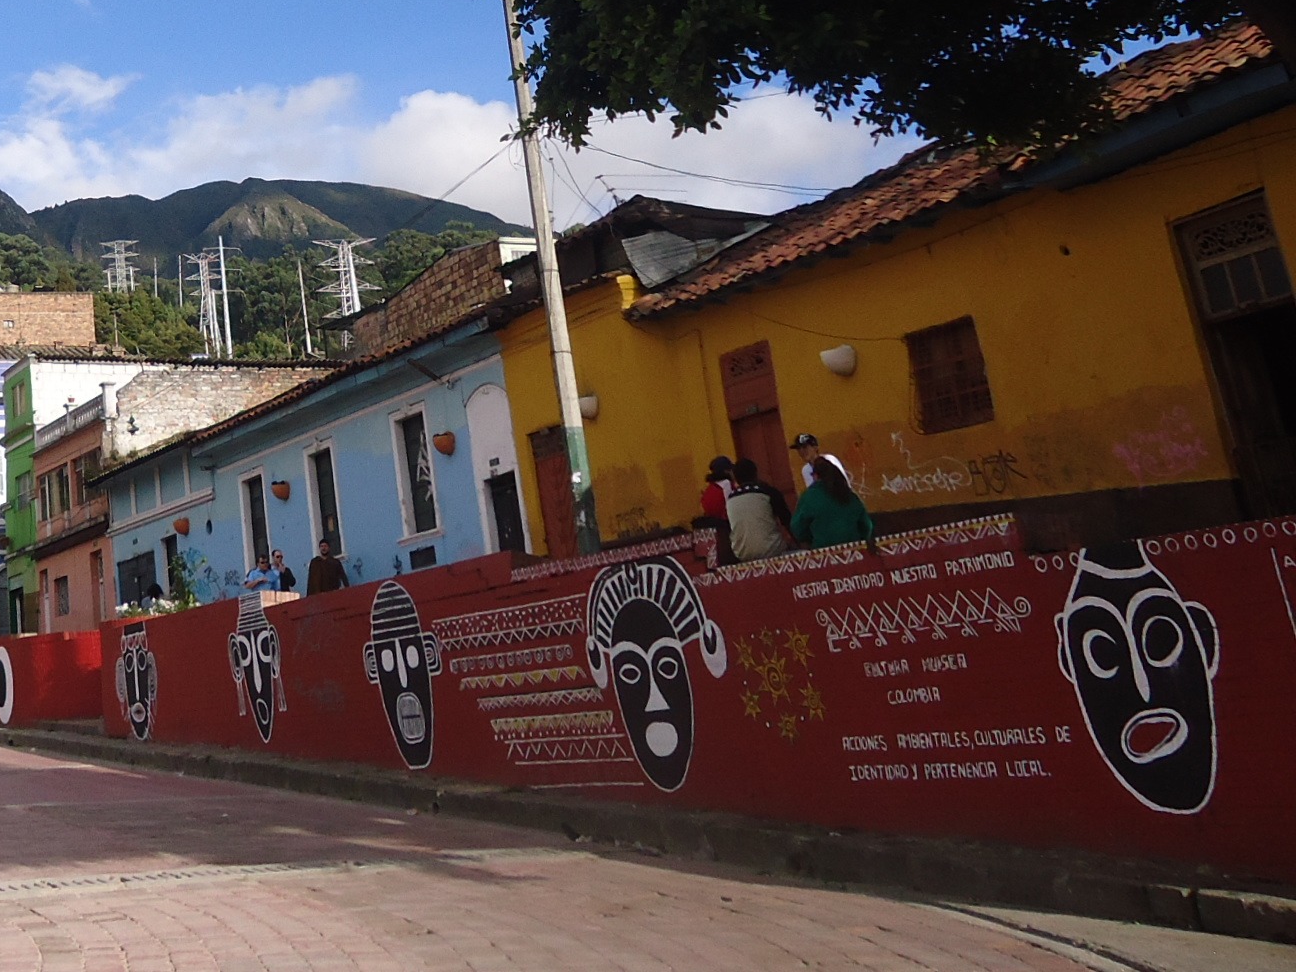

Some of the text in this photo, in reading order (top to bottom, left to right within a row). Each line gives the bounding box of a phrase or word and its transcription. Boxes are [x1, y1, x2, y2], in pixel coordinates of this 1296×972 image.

[792, 551, 1014, 601] NUESTRA IDENTIDAD NUESTRO PATRIMONIO
[887, 686, 941, 705] COLOMBIA
[842, 735, 888, 751] ACCIONES
[974, 726, 1047, 746] CULTURALES
[1055, 726, 1072, 743] DE
[849, 759, 1052, 781] IDENTIDAD Y PERTENENCIA LOCAL.
